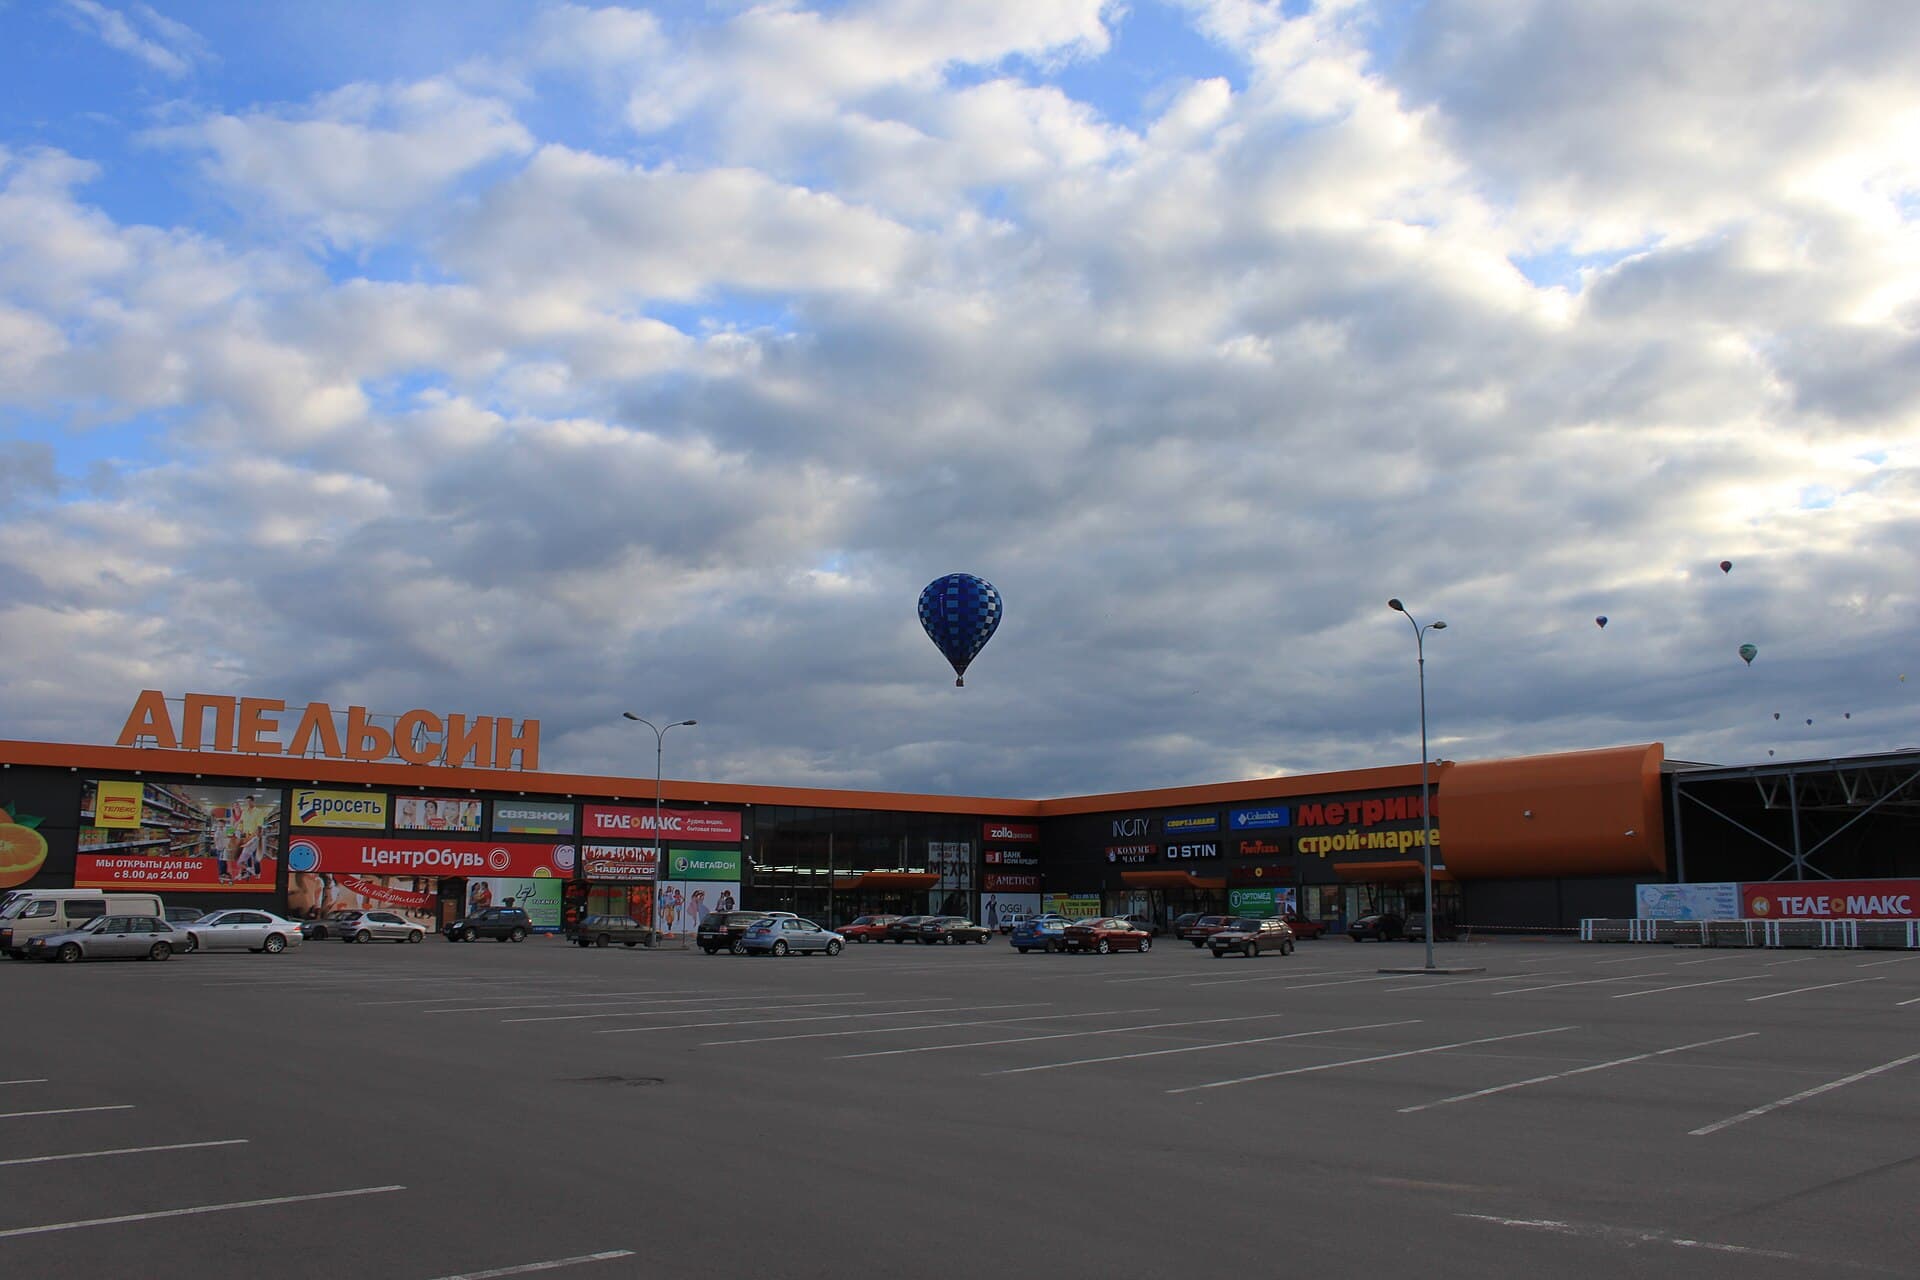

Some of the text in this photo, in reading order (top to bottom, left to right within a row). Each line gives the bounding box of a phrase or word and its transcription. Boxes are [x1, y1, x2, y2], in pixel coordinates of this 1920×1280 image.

[116, 690, 540, 771] АПЕЛЬСИН
[297, 791, 381, 815] Евросеть
[103, 805, 137, 814] ТЕЛЕКС
[1246, 811, 1279, 821] Columbia
[991, 827, 1013, 839] zolla
[1113, 817, 1150, 838] INCITY
[362, 847, 484, 869] ЦентрОбувь
[96, 859, 203, 870] МЫ ОТКРЫТЫ ДЛЯ ВАС
[930, 861, 969, 878] МЕХА
[122, 871, 145, 879] 8.00
[147, 872, 159, 880] до
[160, 872, 189, 880] 24.00
[996, 877, 1037, 887] АМЕТИСТ
[1000, 904, 1023, 913] OGGI
